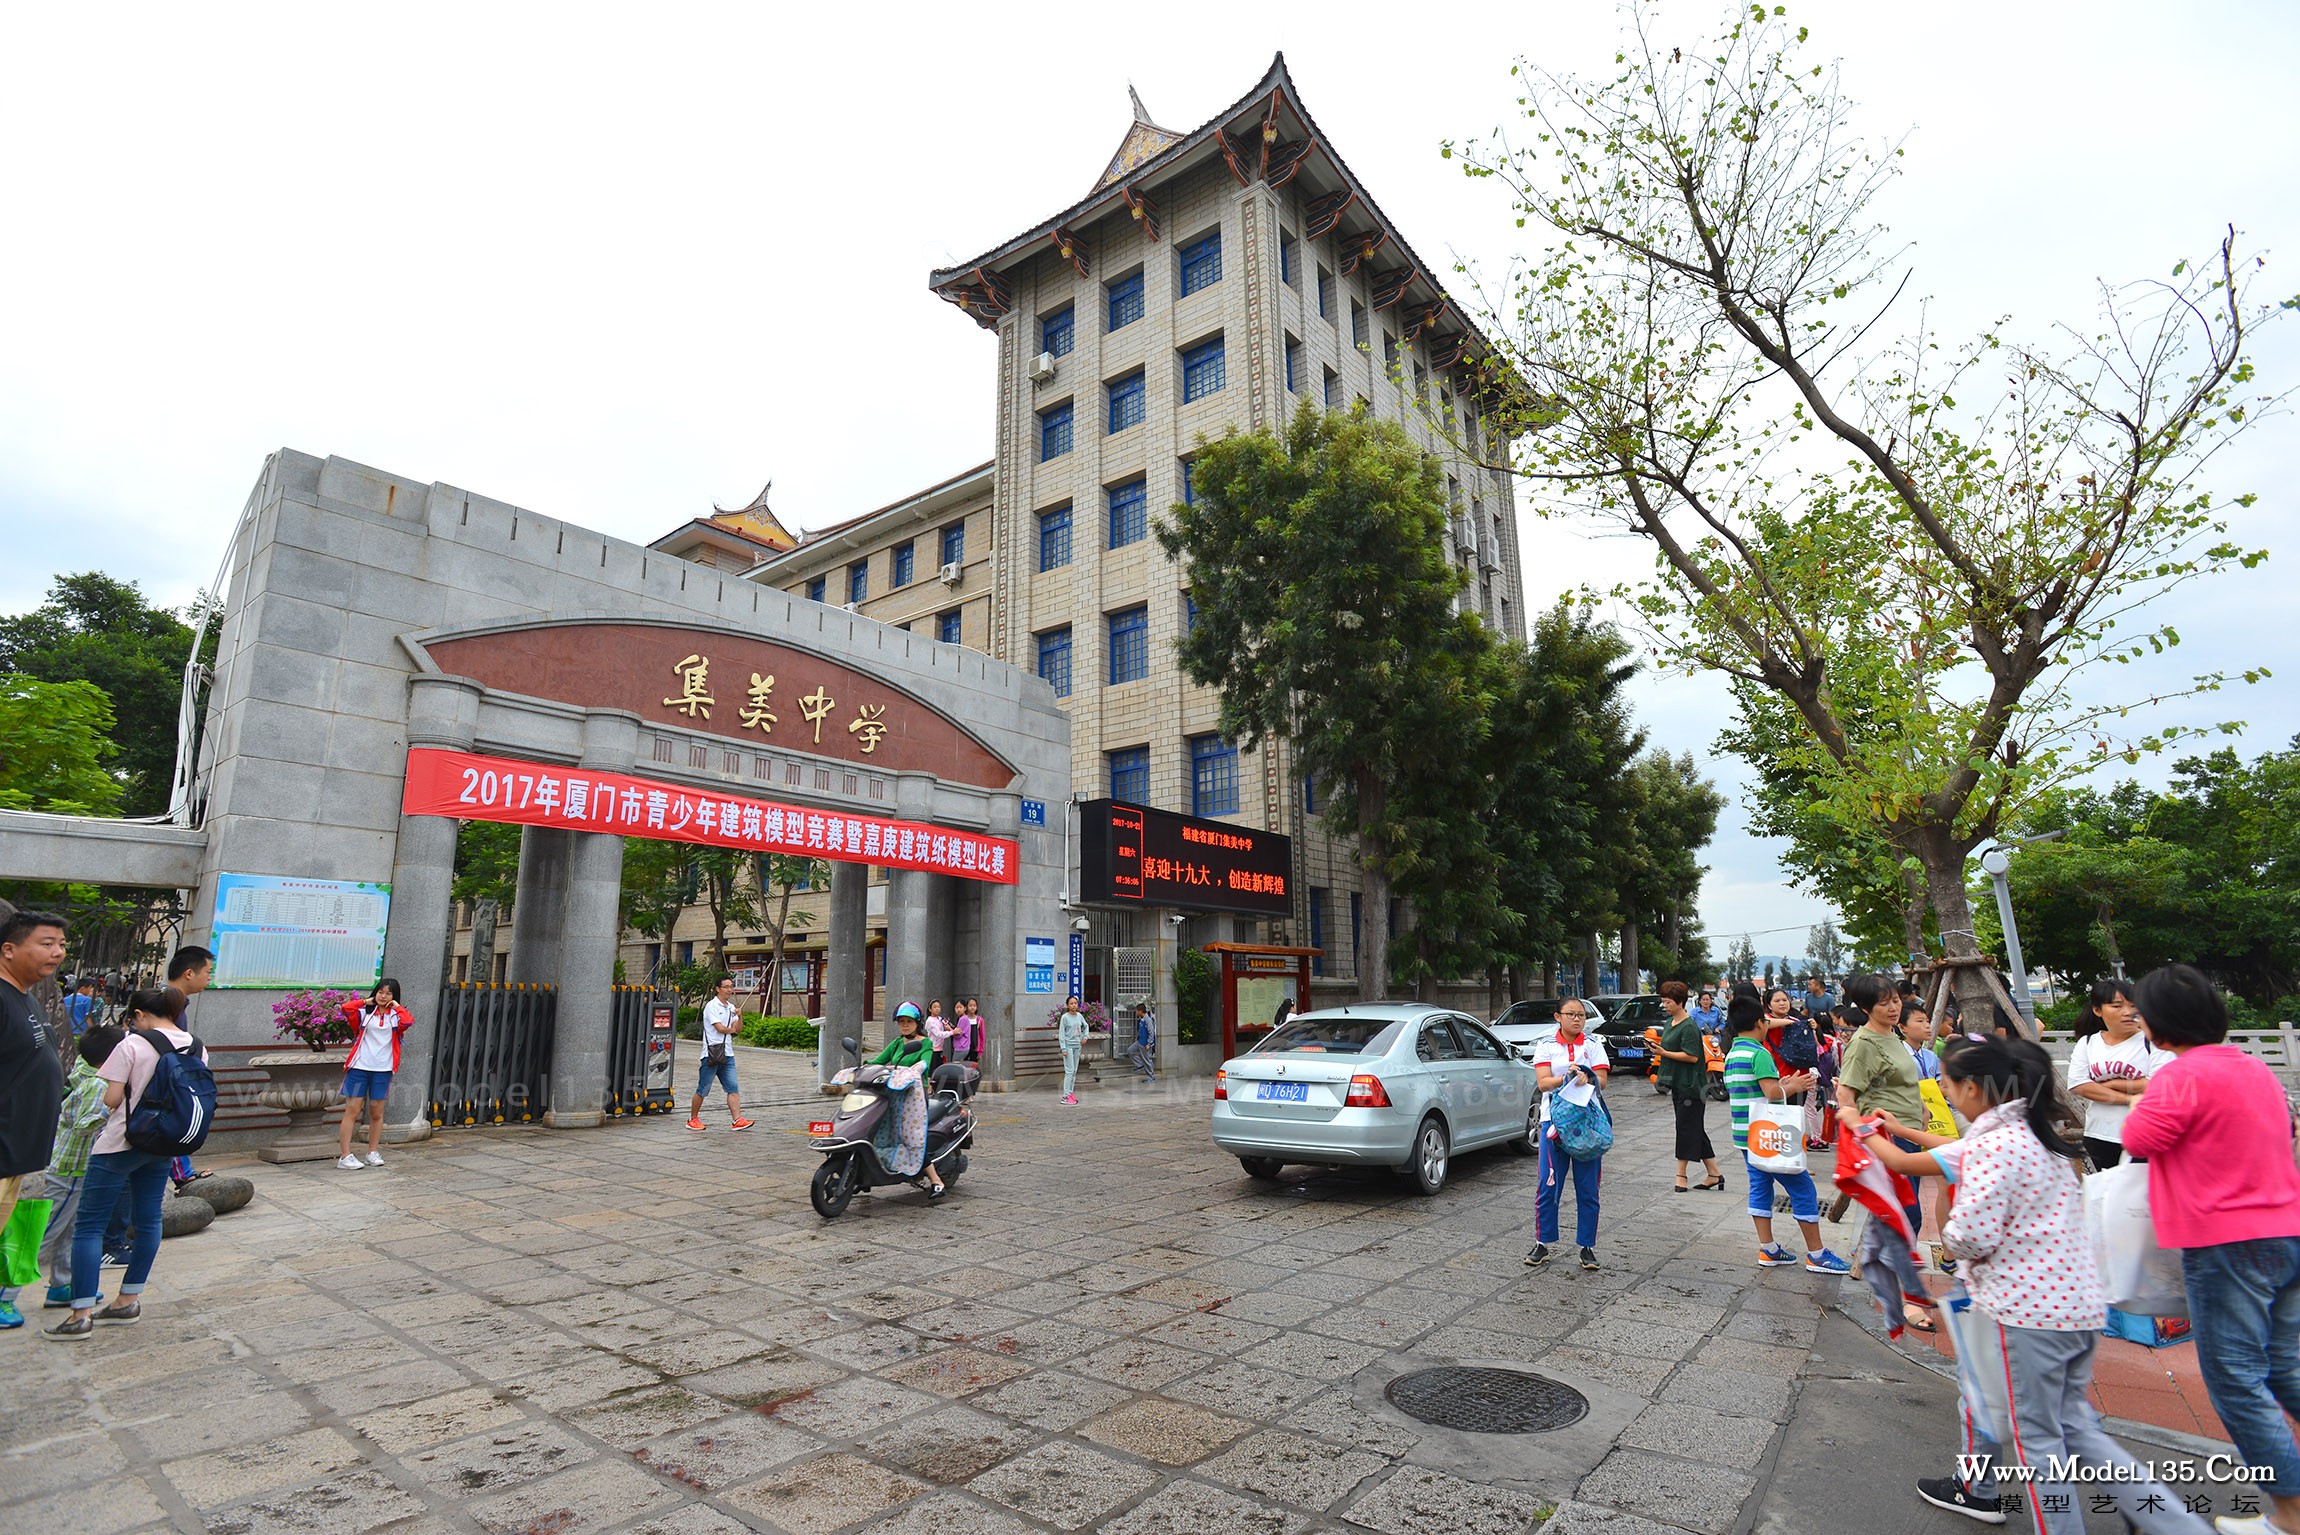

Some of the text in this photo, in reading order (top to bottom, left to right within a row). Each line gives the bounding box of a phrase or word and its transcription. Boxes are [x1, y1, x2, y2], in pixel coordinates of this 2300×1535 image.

[662, 654, 888, 754] 集美中学
[459, 767, 1006, 876] 2017年厦门市青少年建筑模型竞赛暨嘉庚建筑纸模型比赛
[1028, 808, 1037, 819] 19
[1181, 825, 1253, 851] 福建省厦门集美中学
[1758, 1128, 1792, 1141] anta
[1759, 1138, 1793, 1153] kids
